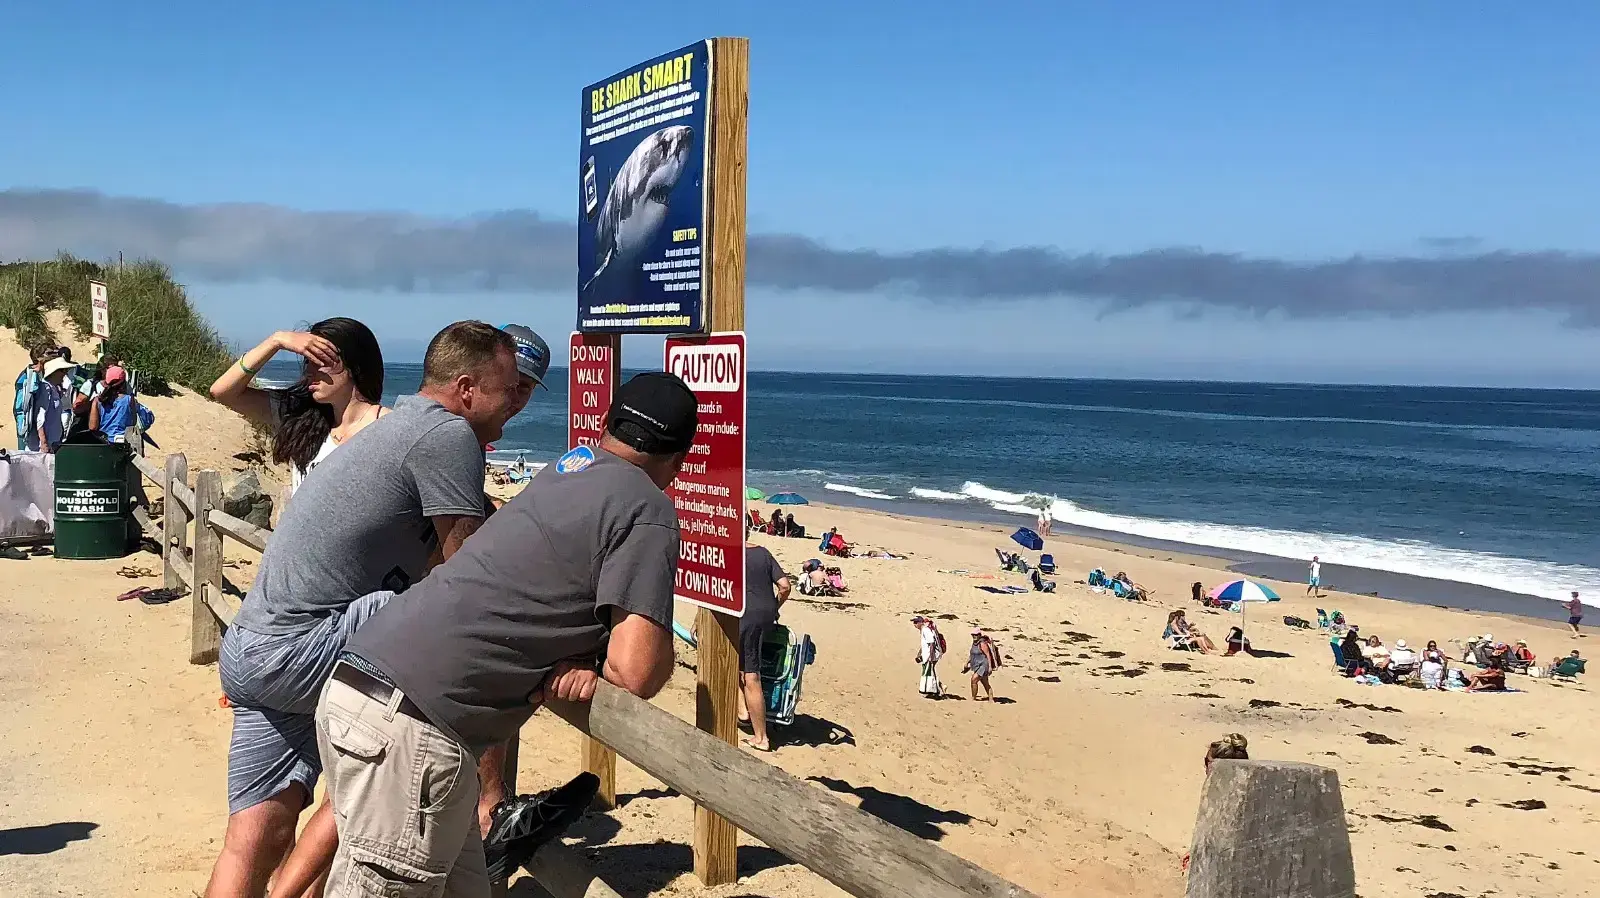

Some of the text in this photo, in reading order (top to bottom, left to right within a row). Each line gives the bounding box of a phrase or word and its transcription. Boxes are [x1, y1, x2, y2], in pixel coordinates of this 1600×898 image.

[592, 87, 604, 114] BE
[606, 71, 642, 108] SHARK
[644, 53, 694, 93] SMART
[572, 346, 609, 362] DO NOT
[576, 368, 604, 385] WALK
[672, 353, 737, 383] CAUTION
[583, 391, 598, 408] ON
[697, 401, 722, 414] azards in
[574, 413, 600, 431] DUNE
[703, 423, 715, 436] may
[716, 421, 739, 435] include:
[689, 444, 710, 455] urrents
[681, 461, 706, 475] avy surf
[674, 477, 730, 497] Dangerous marine
[674, 496, 738, 520] life including: sharks,
[690, 518, 717, 538] jellyfish,
[718, 527, 729, 538] etc.
[680, 540, 725, 569] USE AREA
[685, 570, 710, 595] OWN
[712, 579, 734, 601] RISK
